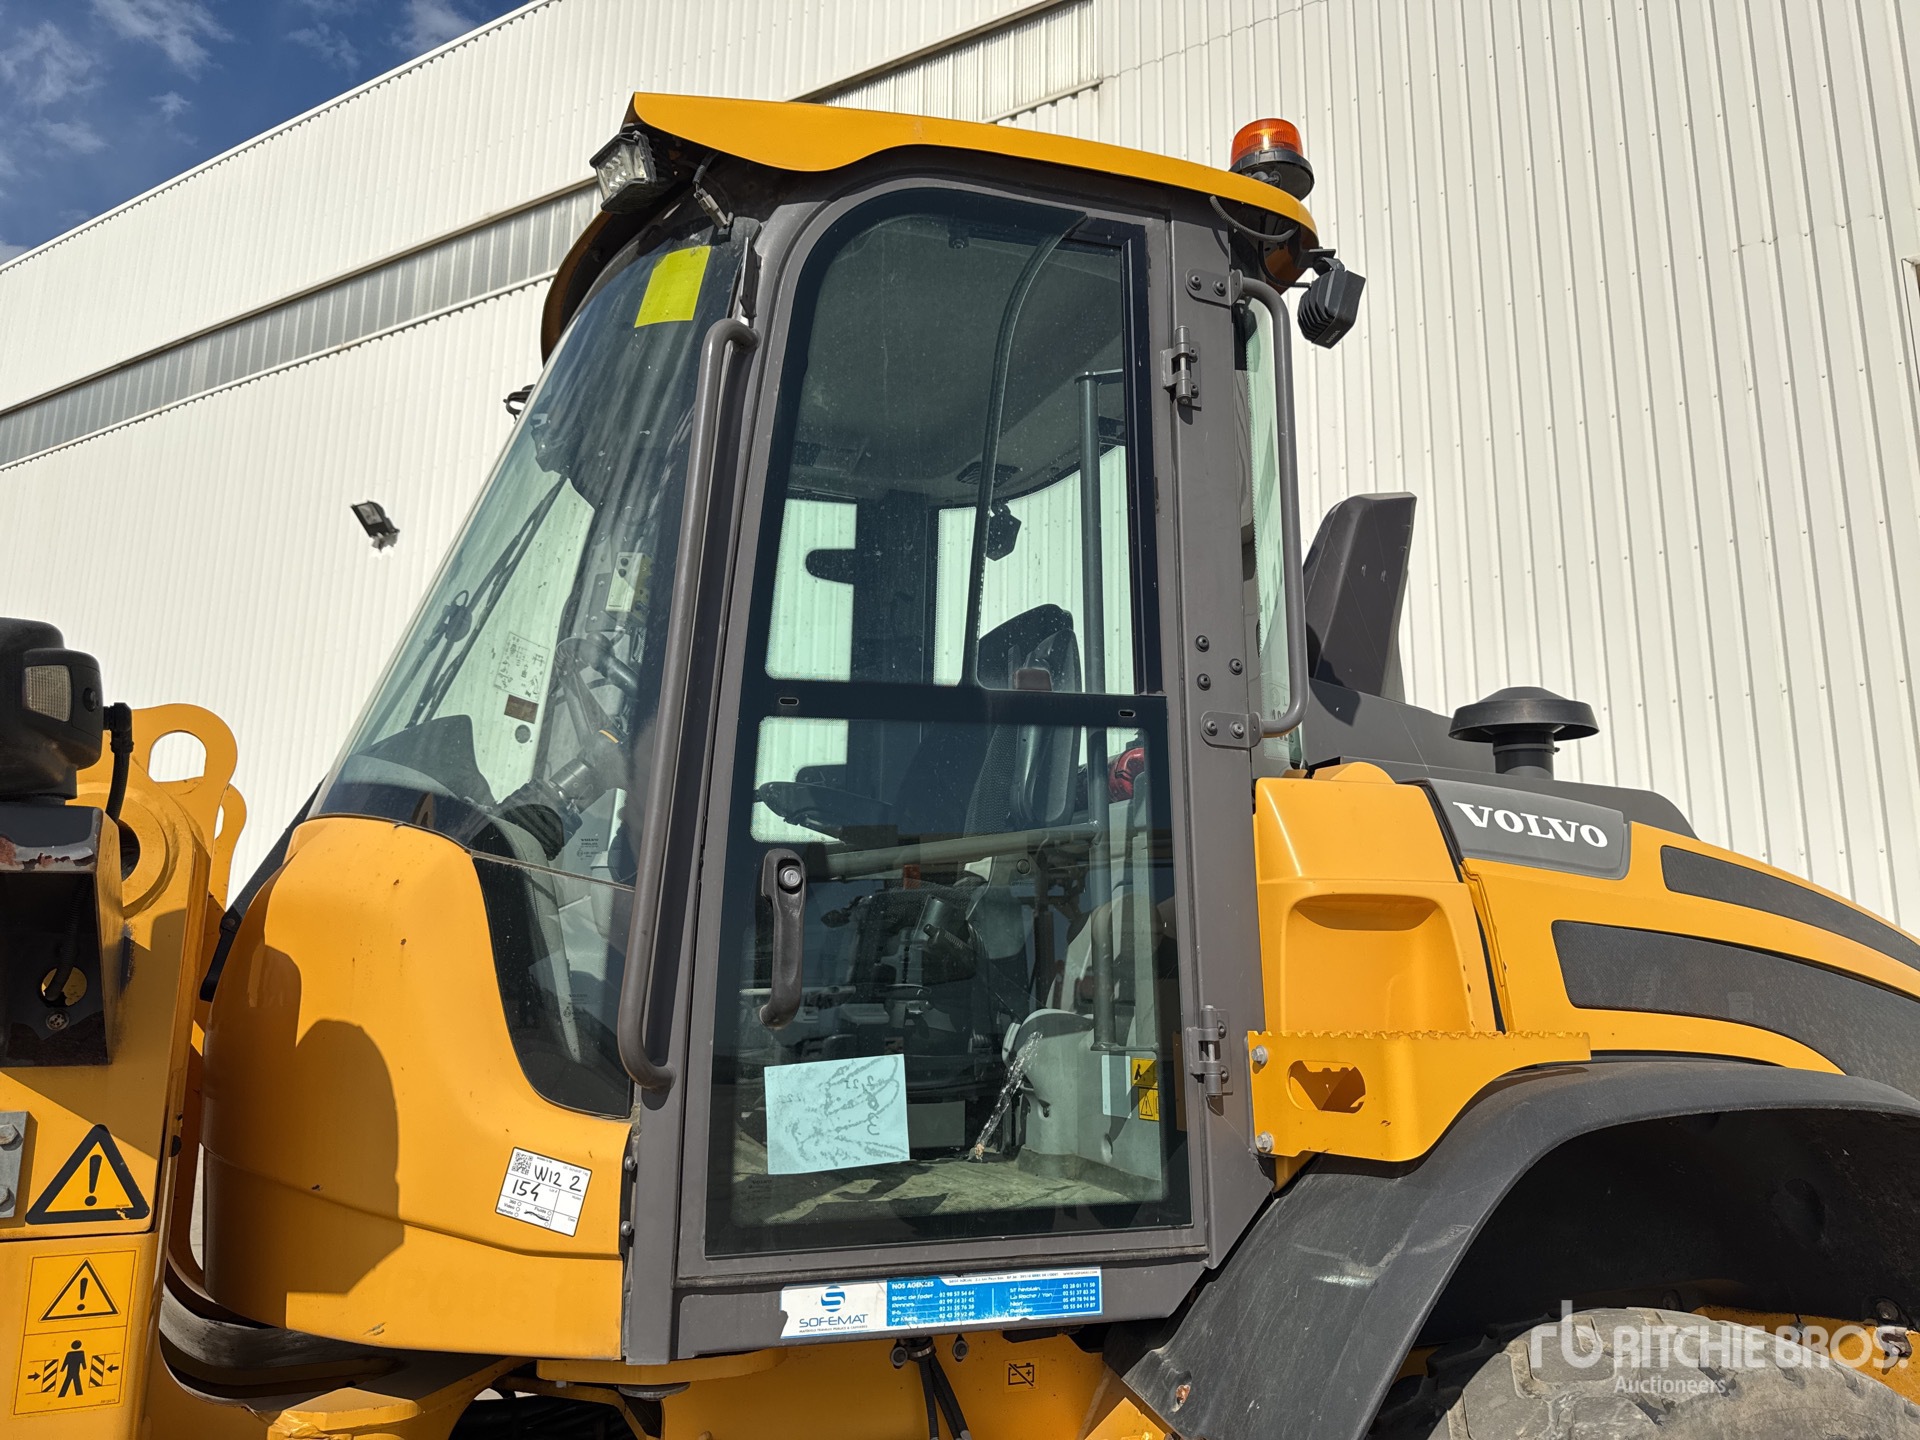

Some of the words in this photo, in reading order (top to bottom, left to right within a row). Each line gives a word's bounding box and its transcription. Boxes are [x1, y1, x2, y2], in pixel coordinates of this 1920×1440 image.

[1453, 801, 1608, 848] VOLVO
[534, 1164, 562, 1188] W12
[569, 1175, 582, 1193] 2
[512, 1179, 541, 1202] 154
[892, 1282, 906, 1290] NOS
[799, 1313, 869, 1329] SOFEMAT
